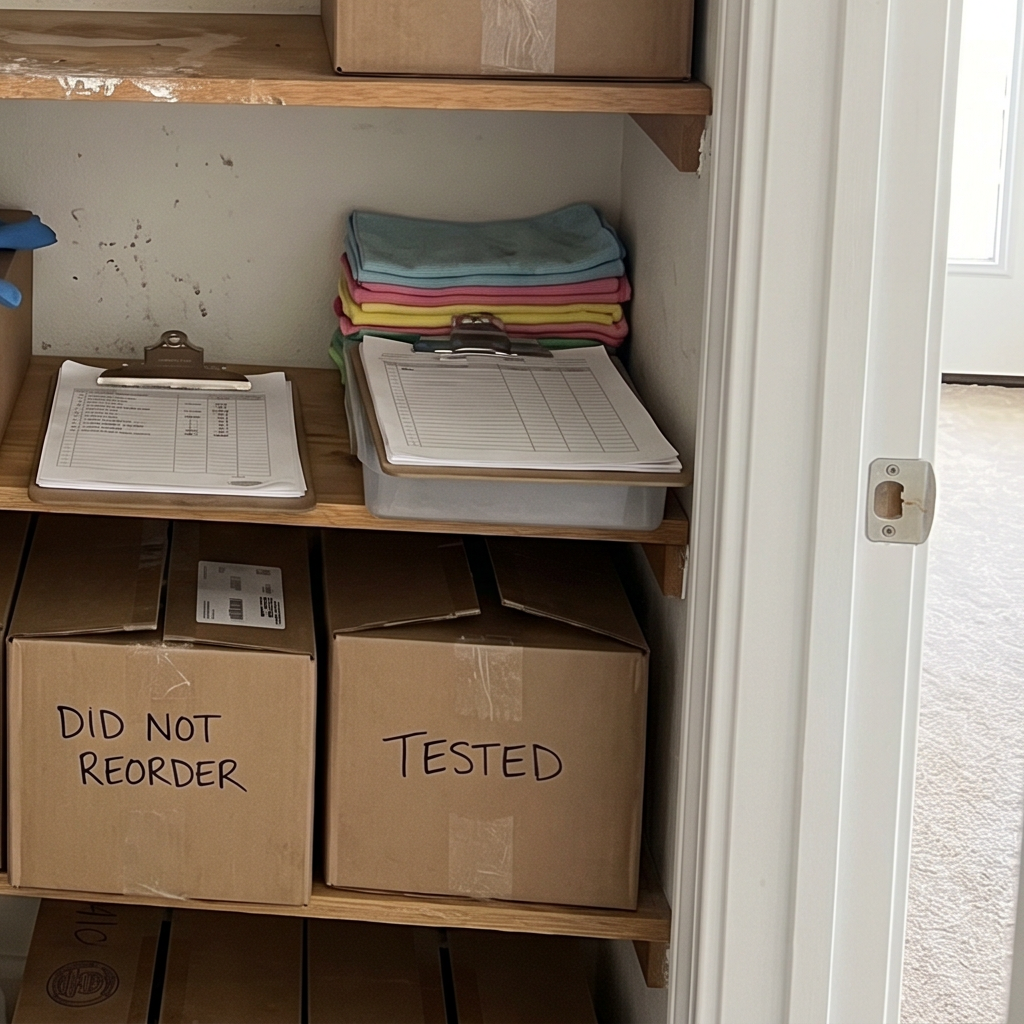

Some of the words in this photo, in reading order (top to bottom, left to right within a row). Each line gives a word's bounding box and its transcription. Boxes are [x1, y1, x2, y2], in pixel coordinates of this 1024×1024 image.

[148, 713, 221, 743] NOT
[80, 752, 247, 792] REORDER
[383, 732, 562, 781] TESTED
